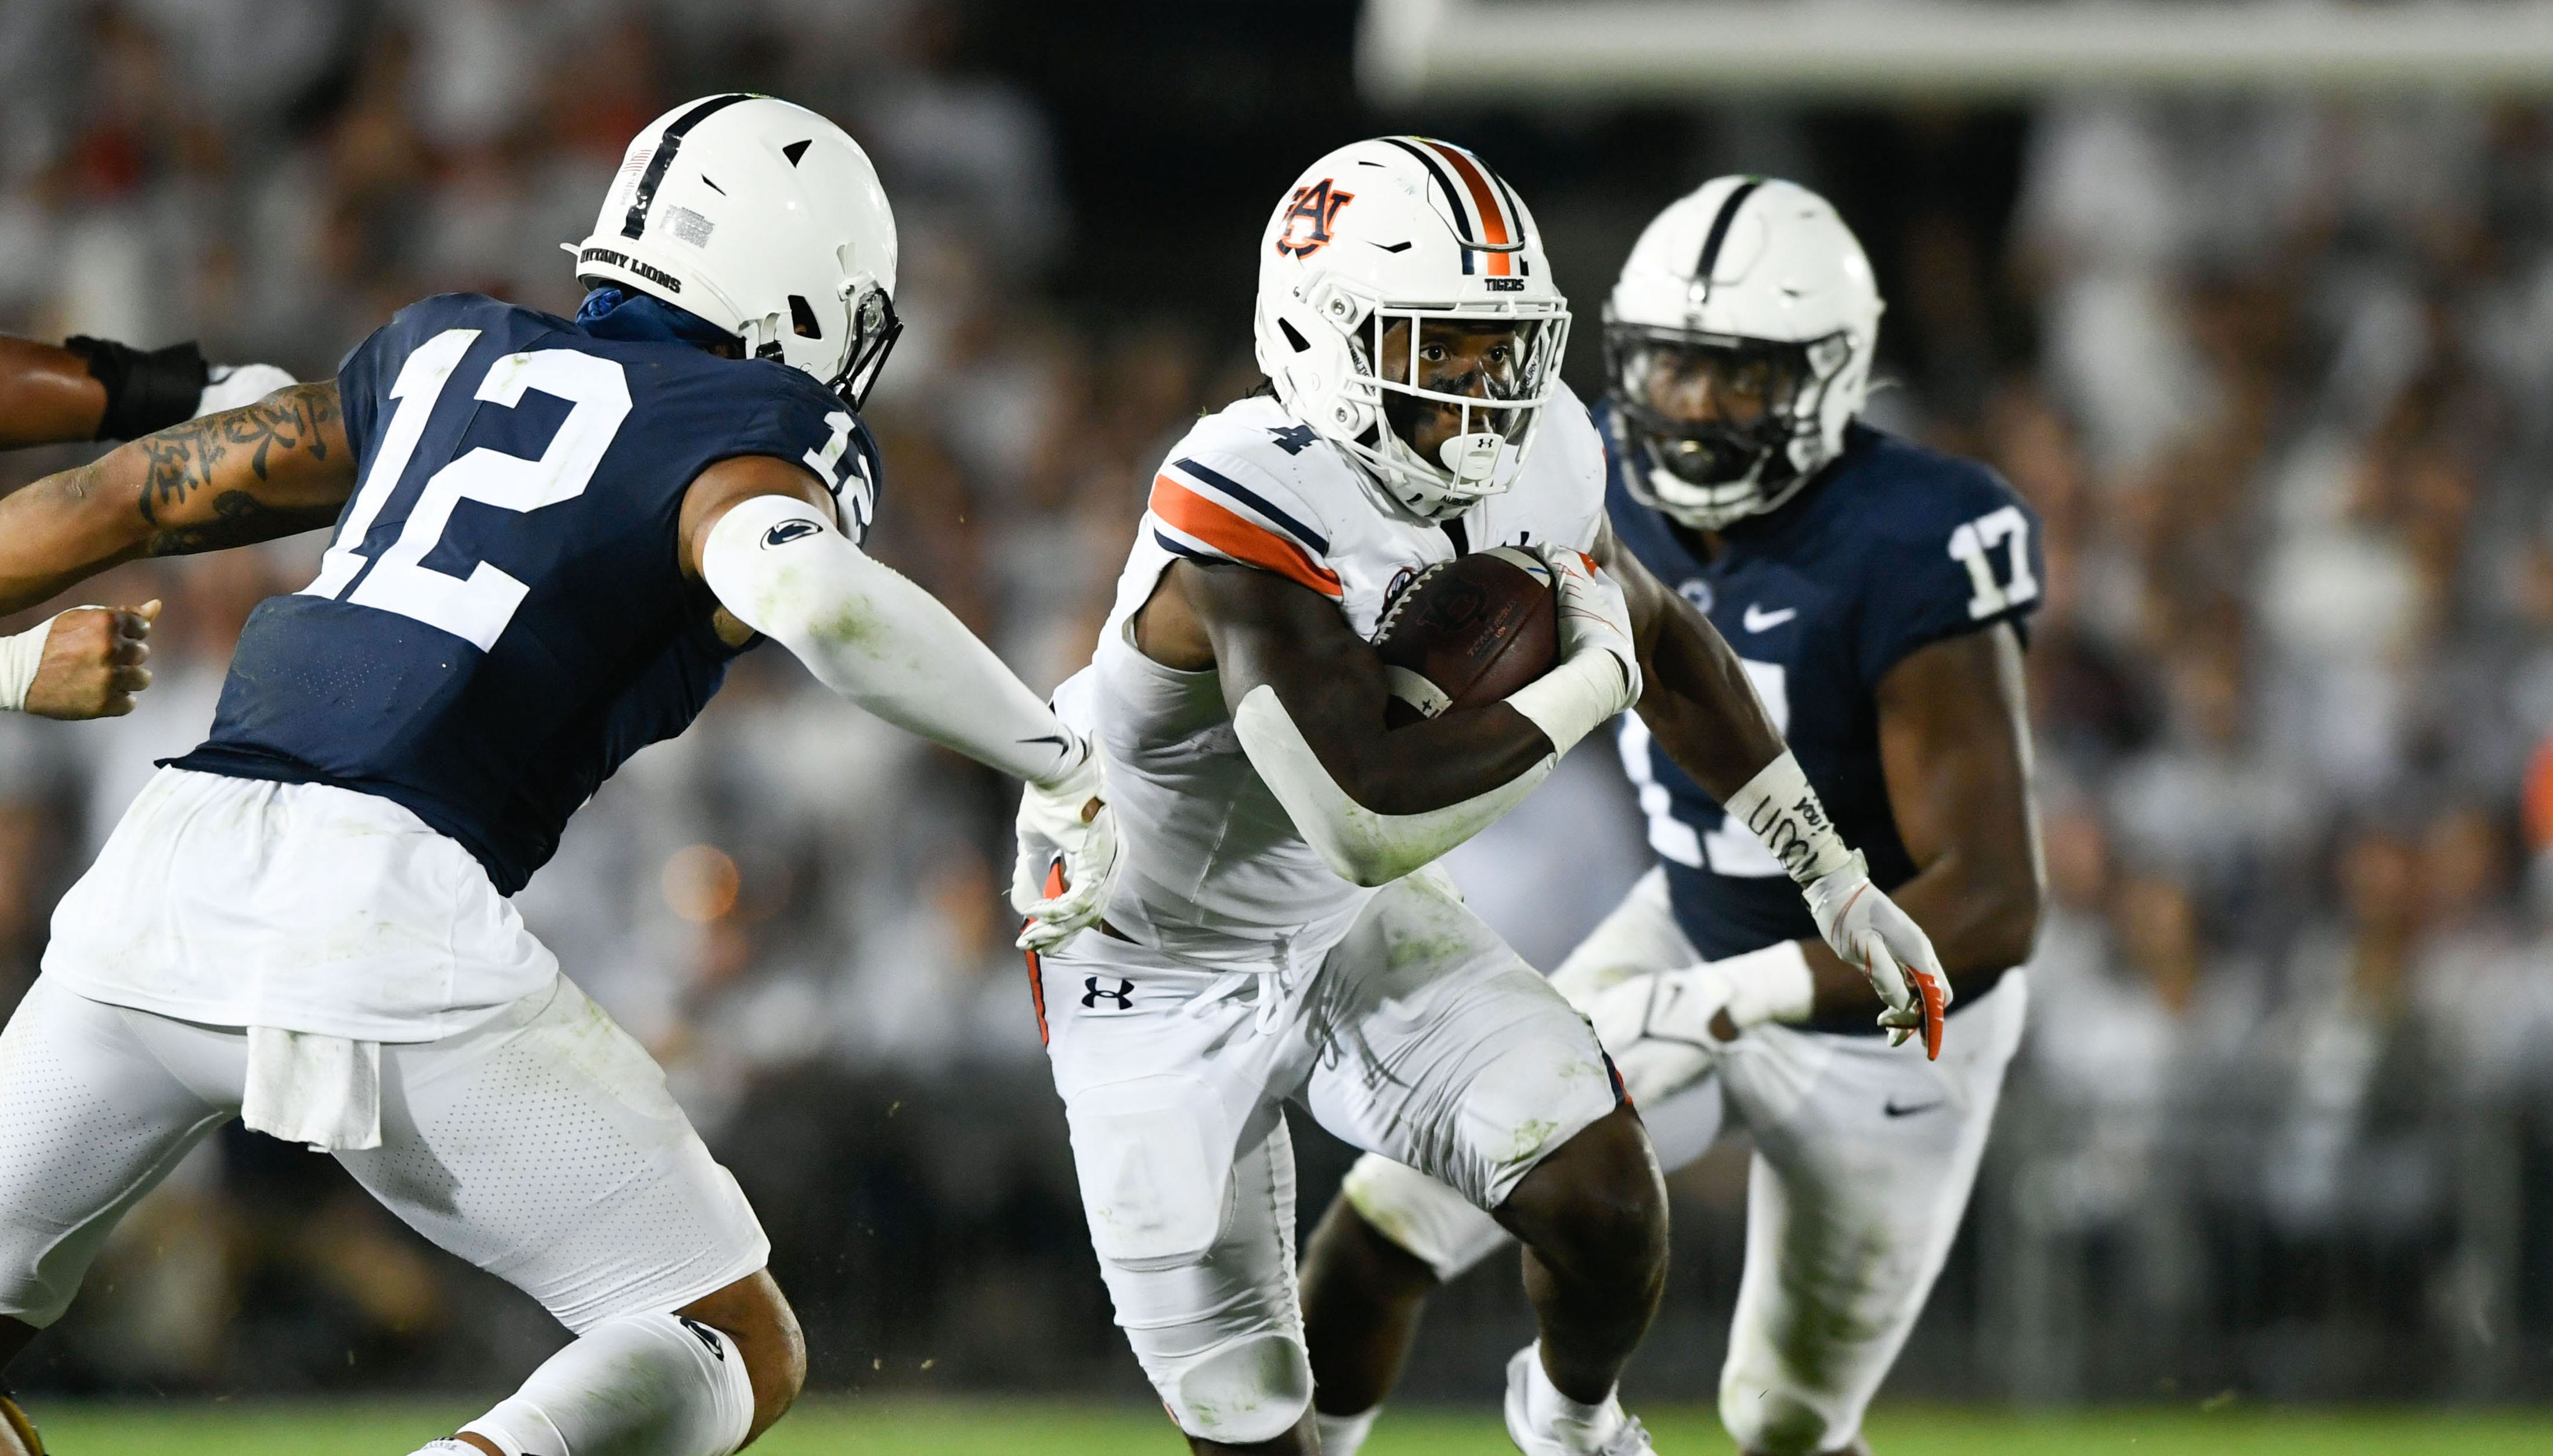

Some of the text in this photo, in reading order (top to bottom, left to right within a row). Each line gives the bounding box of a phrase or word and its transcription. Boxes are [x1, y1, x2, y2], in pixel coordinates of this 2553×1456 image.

[630, 258, 682, 294] LIONS
[1485, 278, 1525, 291] TIGERS
[292, 328, 633, 653] 12
[803, 410, 874, 544] 12
[1948, 504, 2038, 621] 17
